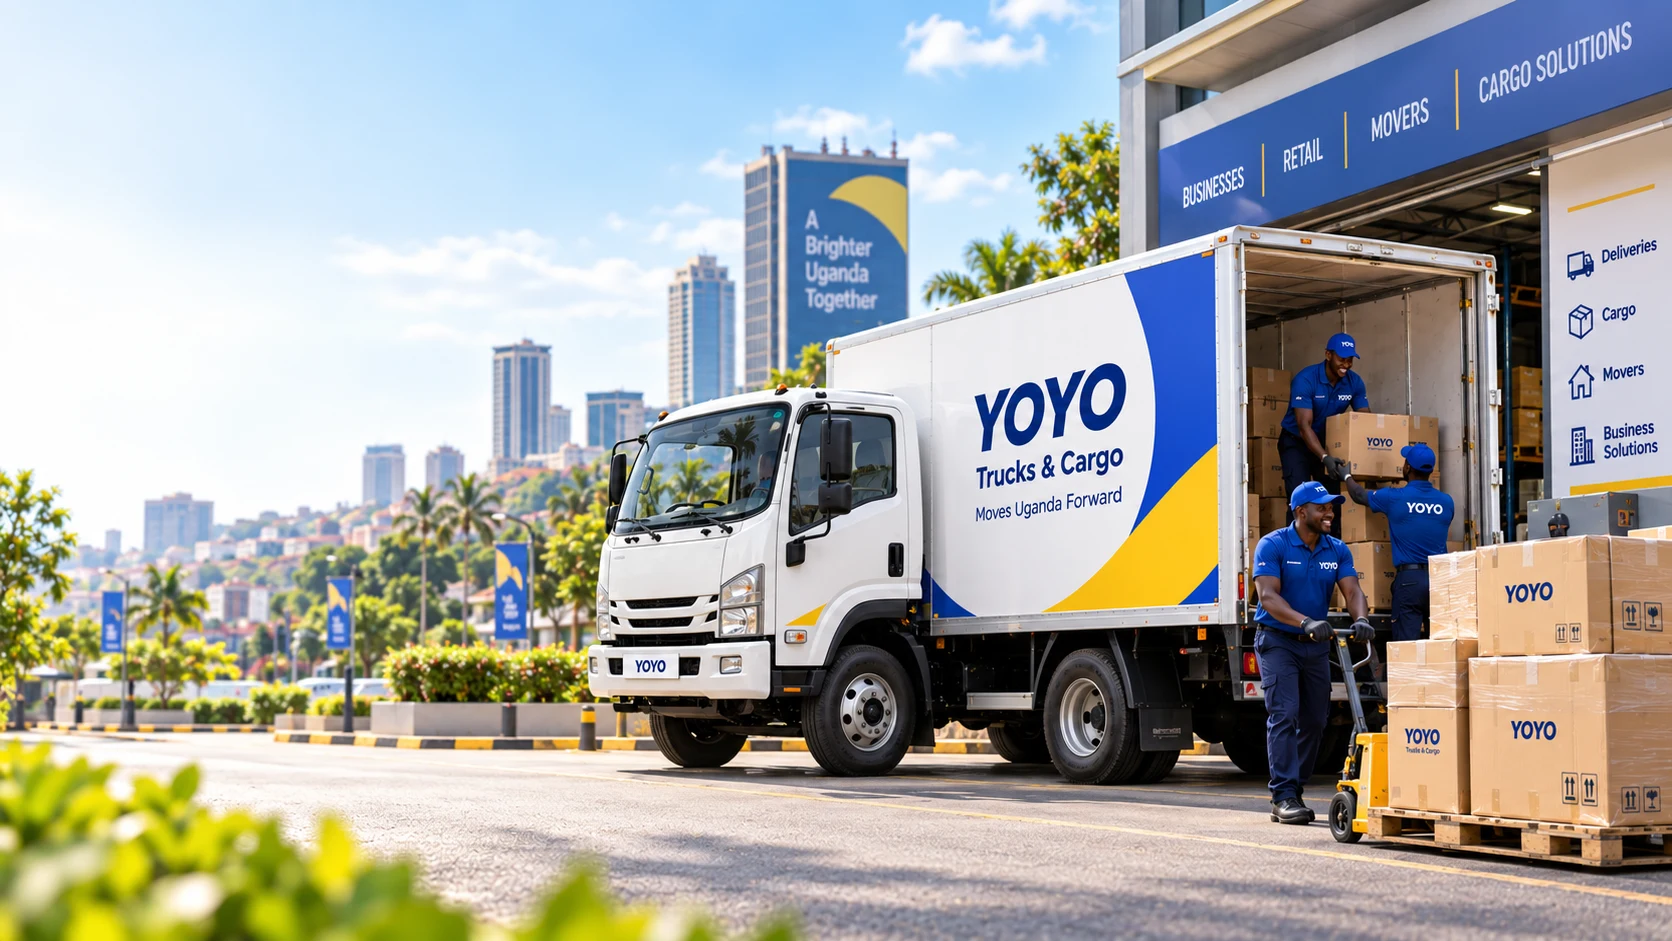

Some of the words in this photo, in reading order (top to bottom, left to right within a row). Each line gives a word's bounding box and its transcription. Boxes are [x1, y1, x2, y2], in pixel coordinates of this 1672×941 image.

[1182, 165, 1245, 209] BUSINESSES
[1283, 137, 1324, 173] RETAIL
[1371, 97, 1430, 143] MOVERS
[1479, 60, 1532, 104] CARGO
[1536, 21, 1633, 82] SOLUTIONS
[805, 210, 819, 229] A
[805, 235, 873, 260] Brighter
[1601, 238, 1658, 264] Deliveries
[805, 261, 869, 286] Uganda
[805, 288, 878, 313] Together
[1602, 304, 1637, 322] Cargo
[1603, 364, 1645, 382] Movers
[974, 362, 1127, 453] YOYO
[1603, 420, 1655, 441] Business
[1366, 437, 1393, 447] YOYO
[1603, 438, 1659, 460] Solutions
[976, 459, 1036, 490] Trucks
[1041, 454, 1056, 479] &
[1060, 447, 1124, 476] Cargo
[975, 506, 1012, 522] Moves
[1015, 495, 1062, 520] Uganda
[1066, 485, 1123, 510] Forward
[1407, 502, 1444, 515] YOYO
[1319, 561, 1338, 570] YOYO
[1504, 581, 1554, 604] YOYO
[635, 659, 667, 673] YOYO
[1404, 728, 1441, 745] YOYO
[1511, 720, 1557, 741] YOYO
